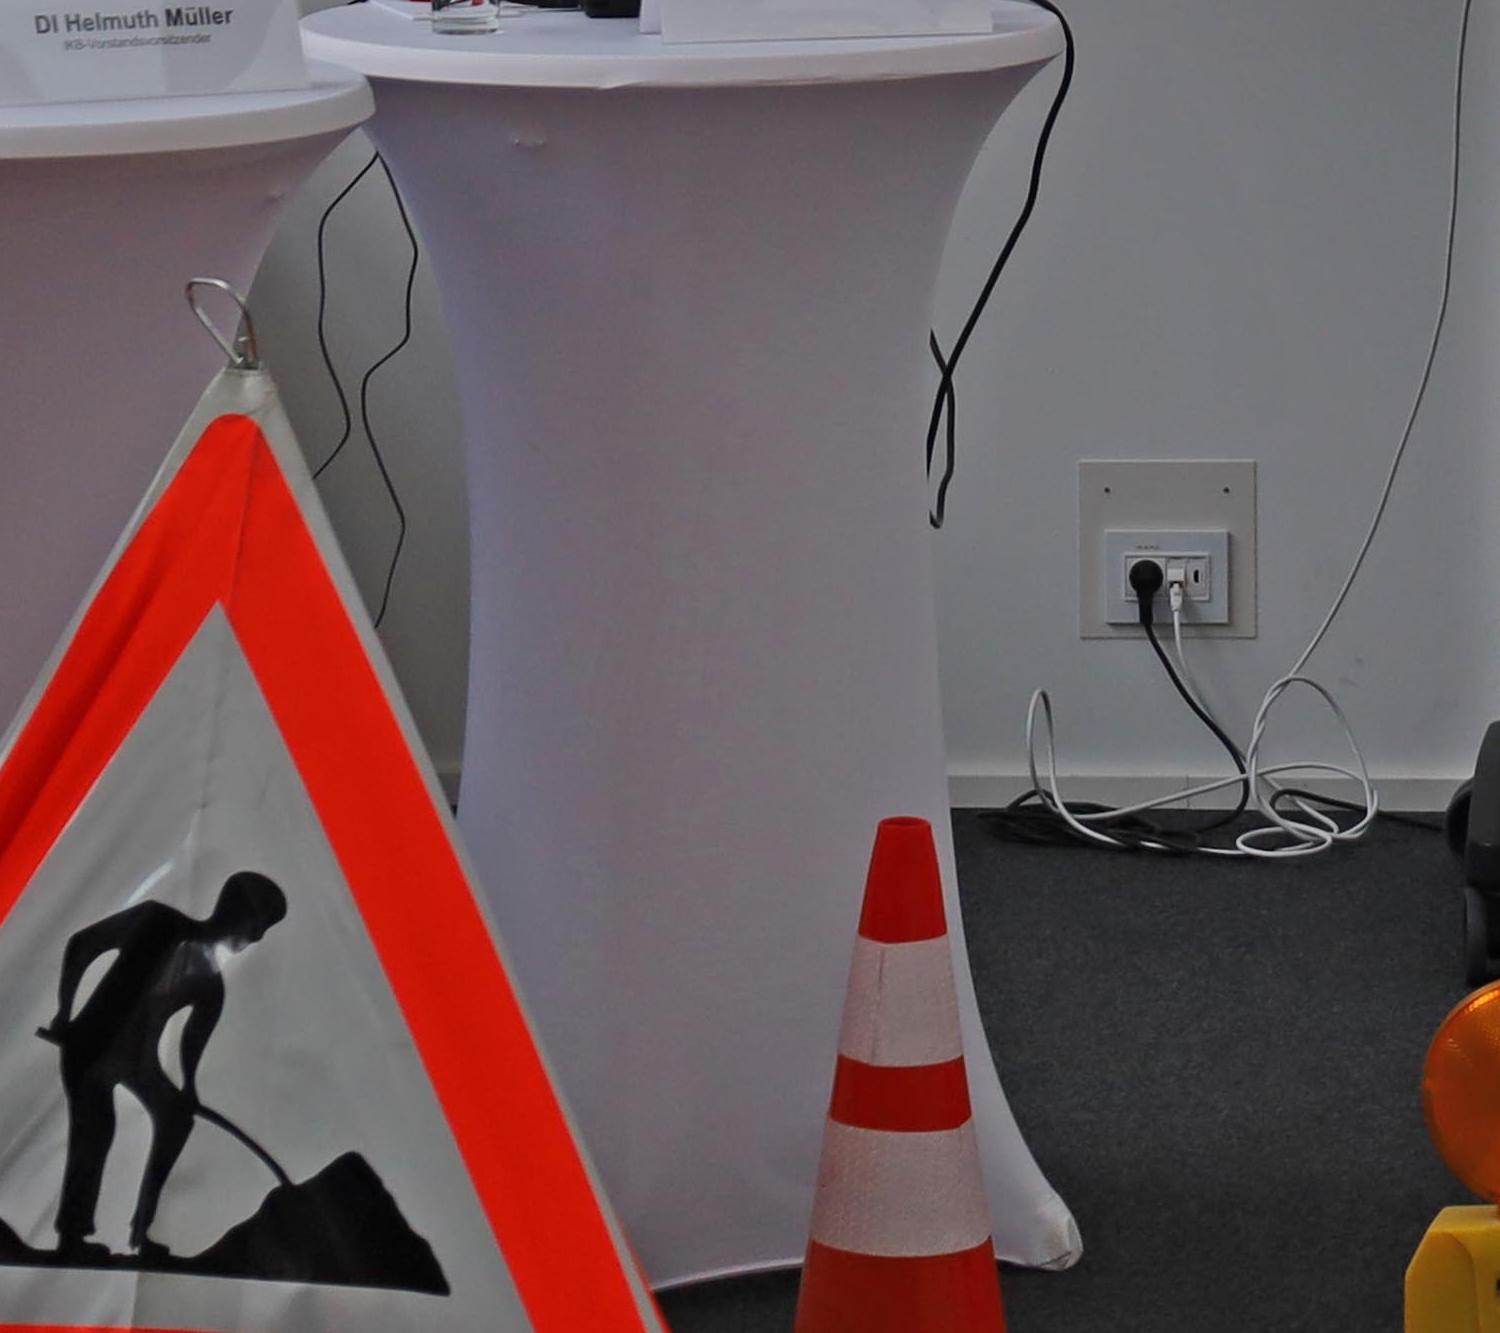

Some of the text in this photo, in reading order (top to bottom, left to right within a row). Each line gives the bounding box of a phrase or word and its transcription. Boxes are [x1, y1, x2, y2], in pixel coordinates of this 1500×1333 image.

[35, 5, 234, 34] DI Helmuth Müller
